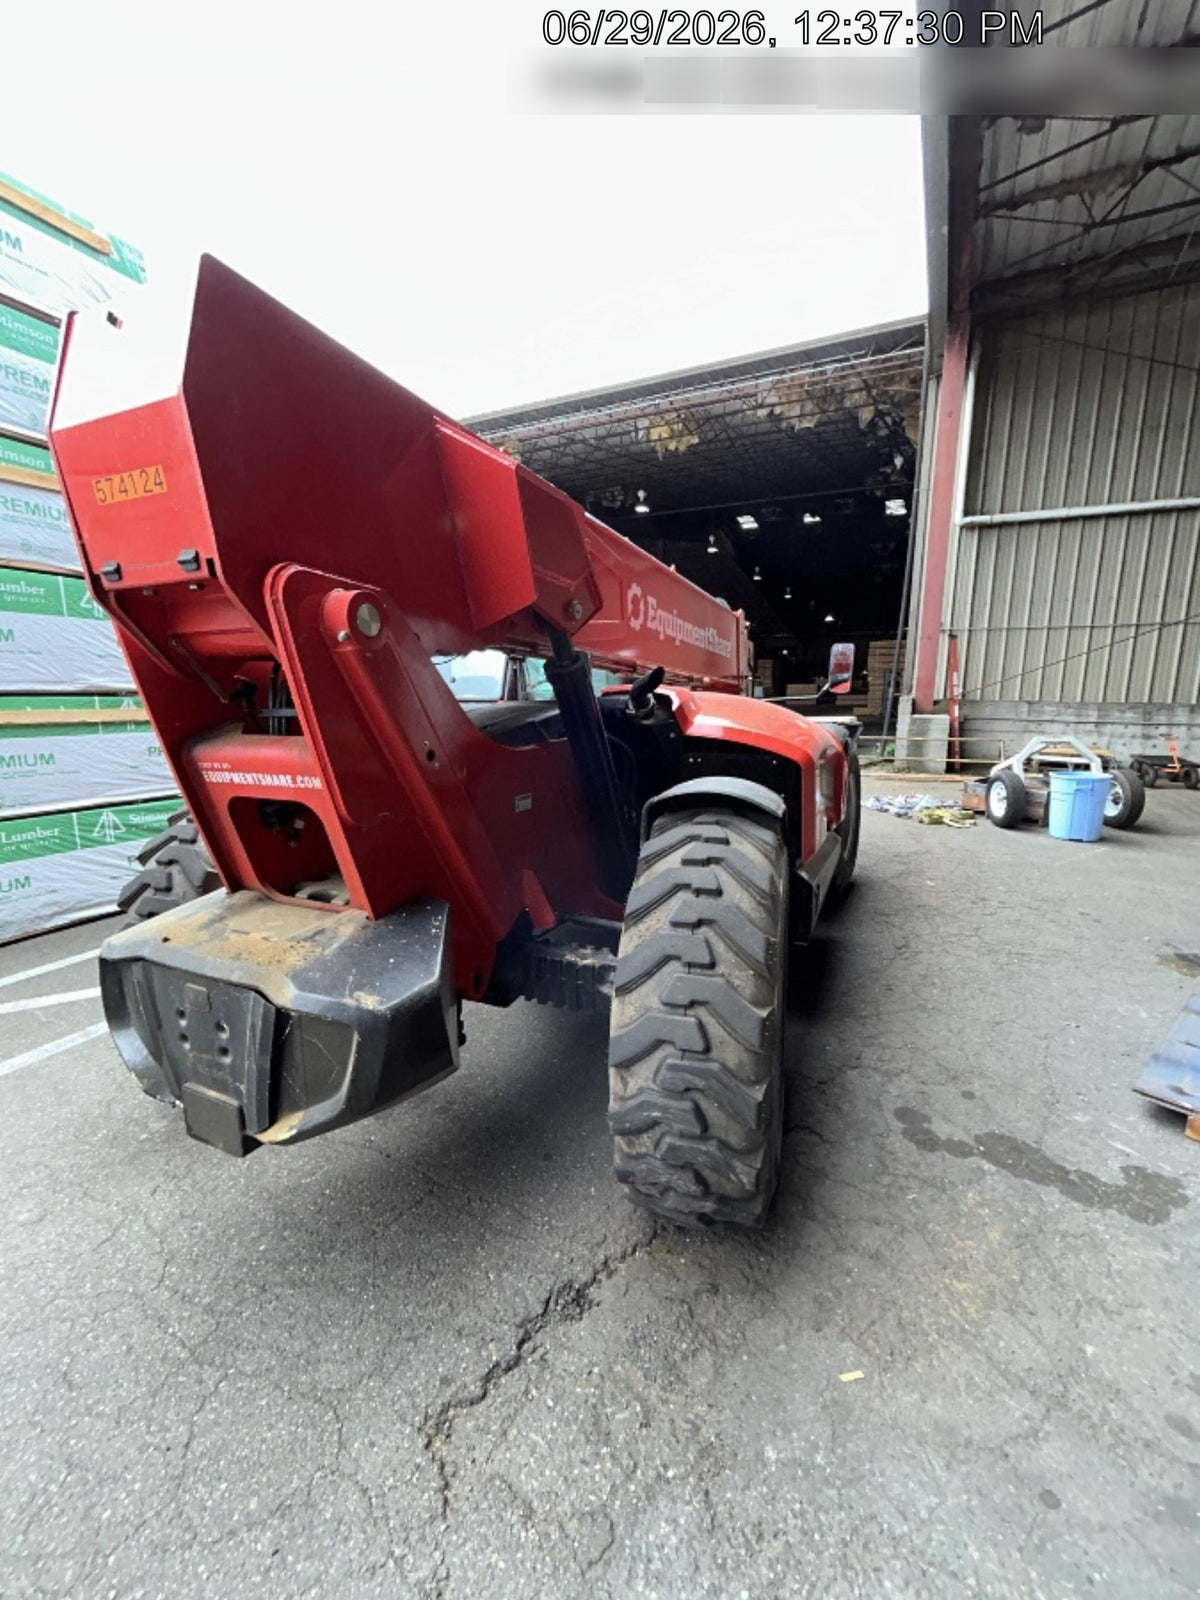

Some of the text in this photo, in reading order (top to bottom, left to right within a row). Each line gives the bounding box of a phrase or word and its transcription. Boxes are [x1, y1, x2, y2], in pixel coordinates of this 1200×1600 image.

[95, 466, 164, 503] 574124
[646, 595, 732, 658] EquipmentShare
[201, 770, 323, 790] EQUIPMENTSHARE.COM
[1, 827, 60, 843] Lumber
